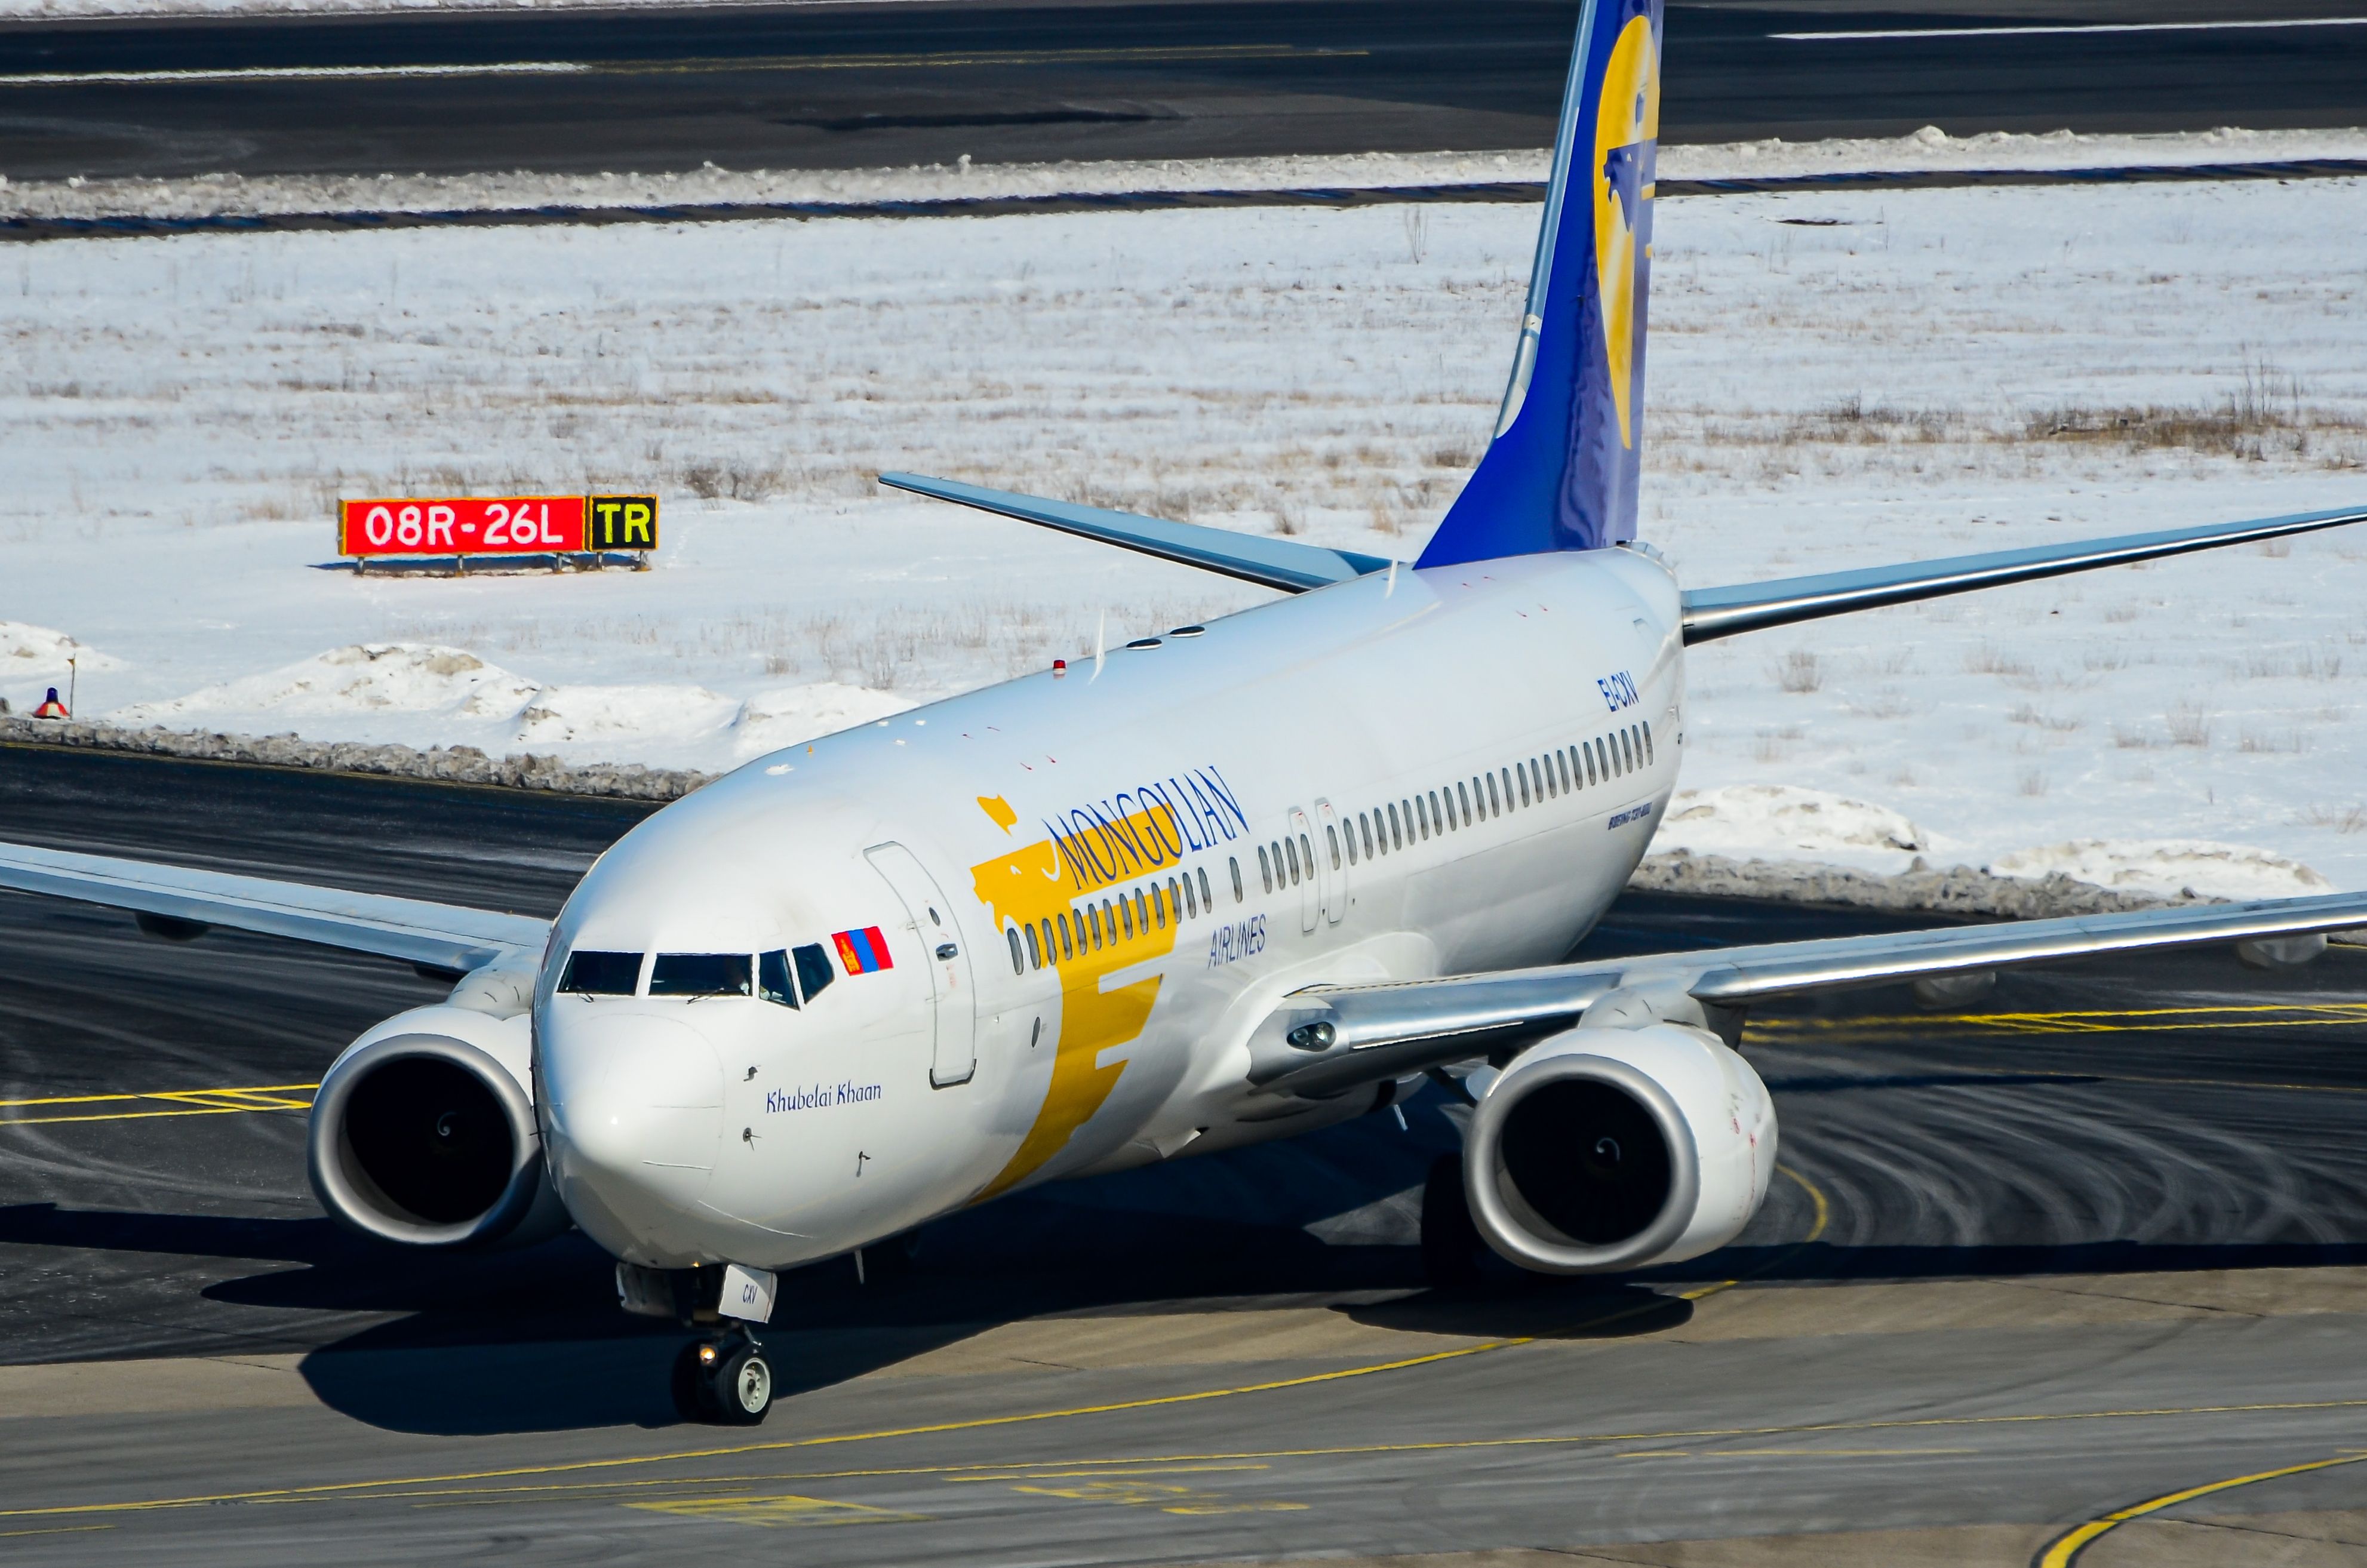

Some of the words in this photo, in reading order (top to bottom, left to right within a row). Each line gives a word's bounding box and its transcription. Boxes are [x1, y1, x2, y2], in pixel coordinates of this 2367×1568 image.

[365, 503, 564, 546] 08R-26L
[597, 503, 650, 543] TR
[1597, 670, 1640, 712] EI-CXV
[1041, 765, 1251, 891] MONGOLIAN
[1207, 913, 1267, 970] AIRLINES
[766, 1083, 832, 1114] Khubelai
[837, 1079, 881, 1105] Khaan
[742, 1284, 758, 1304] CXV
